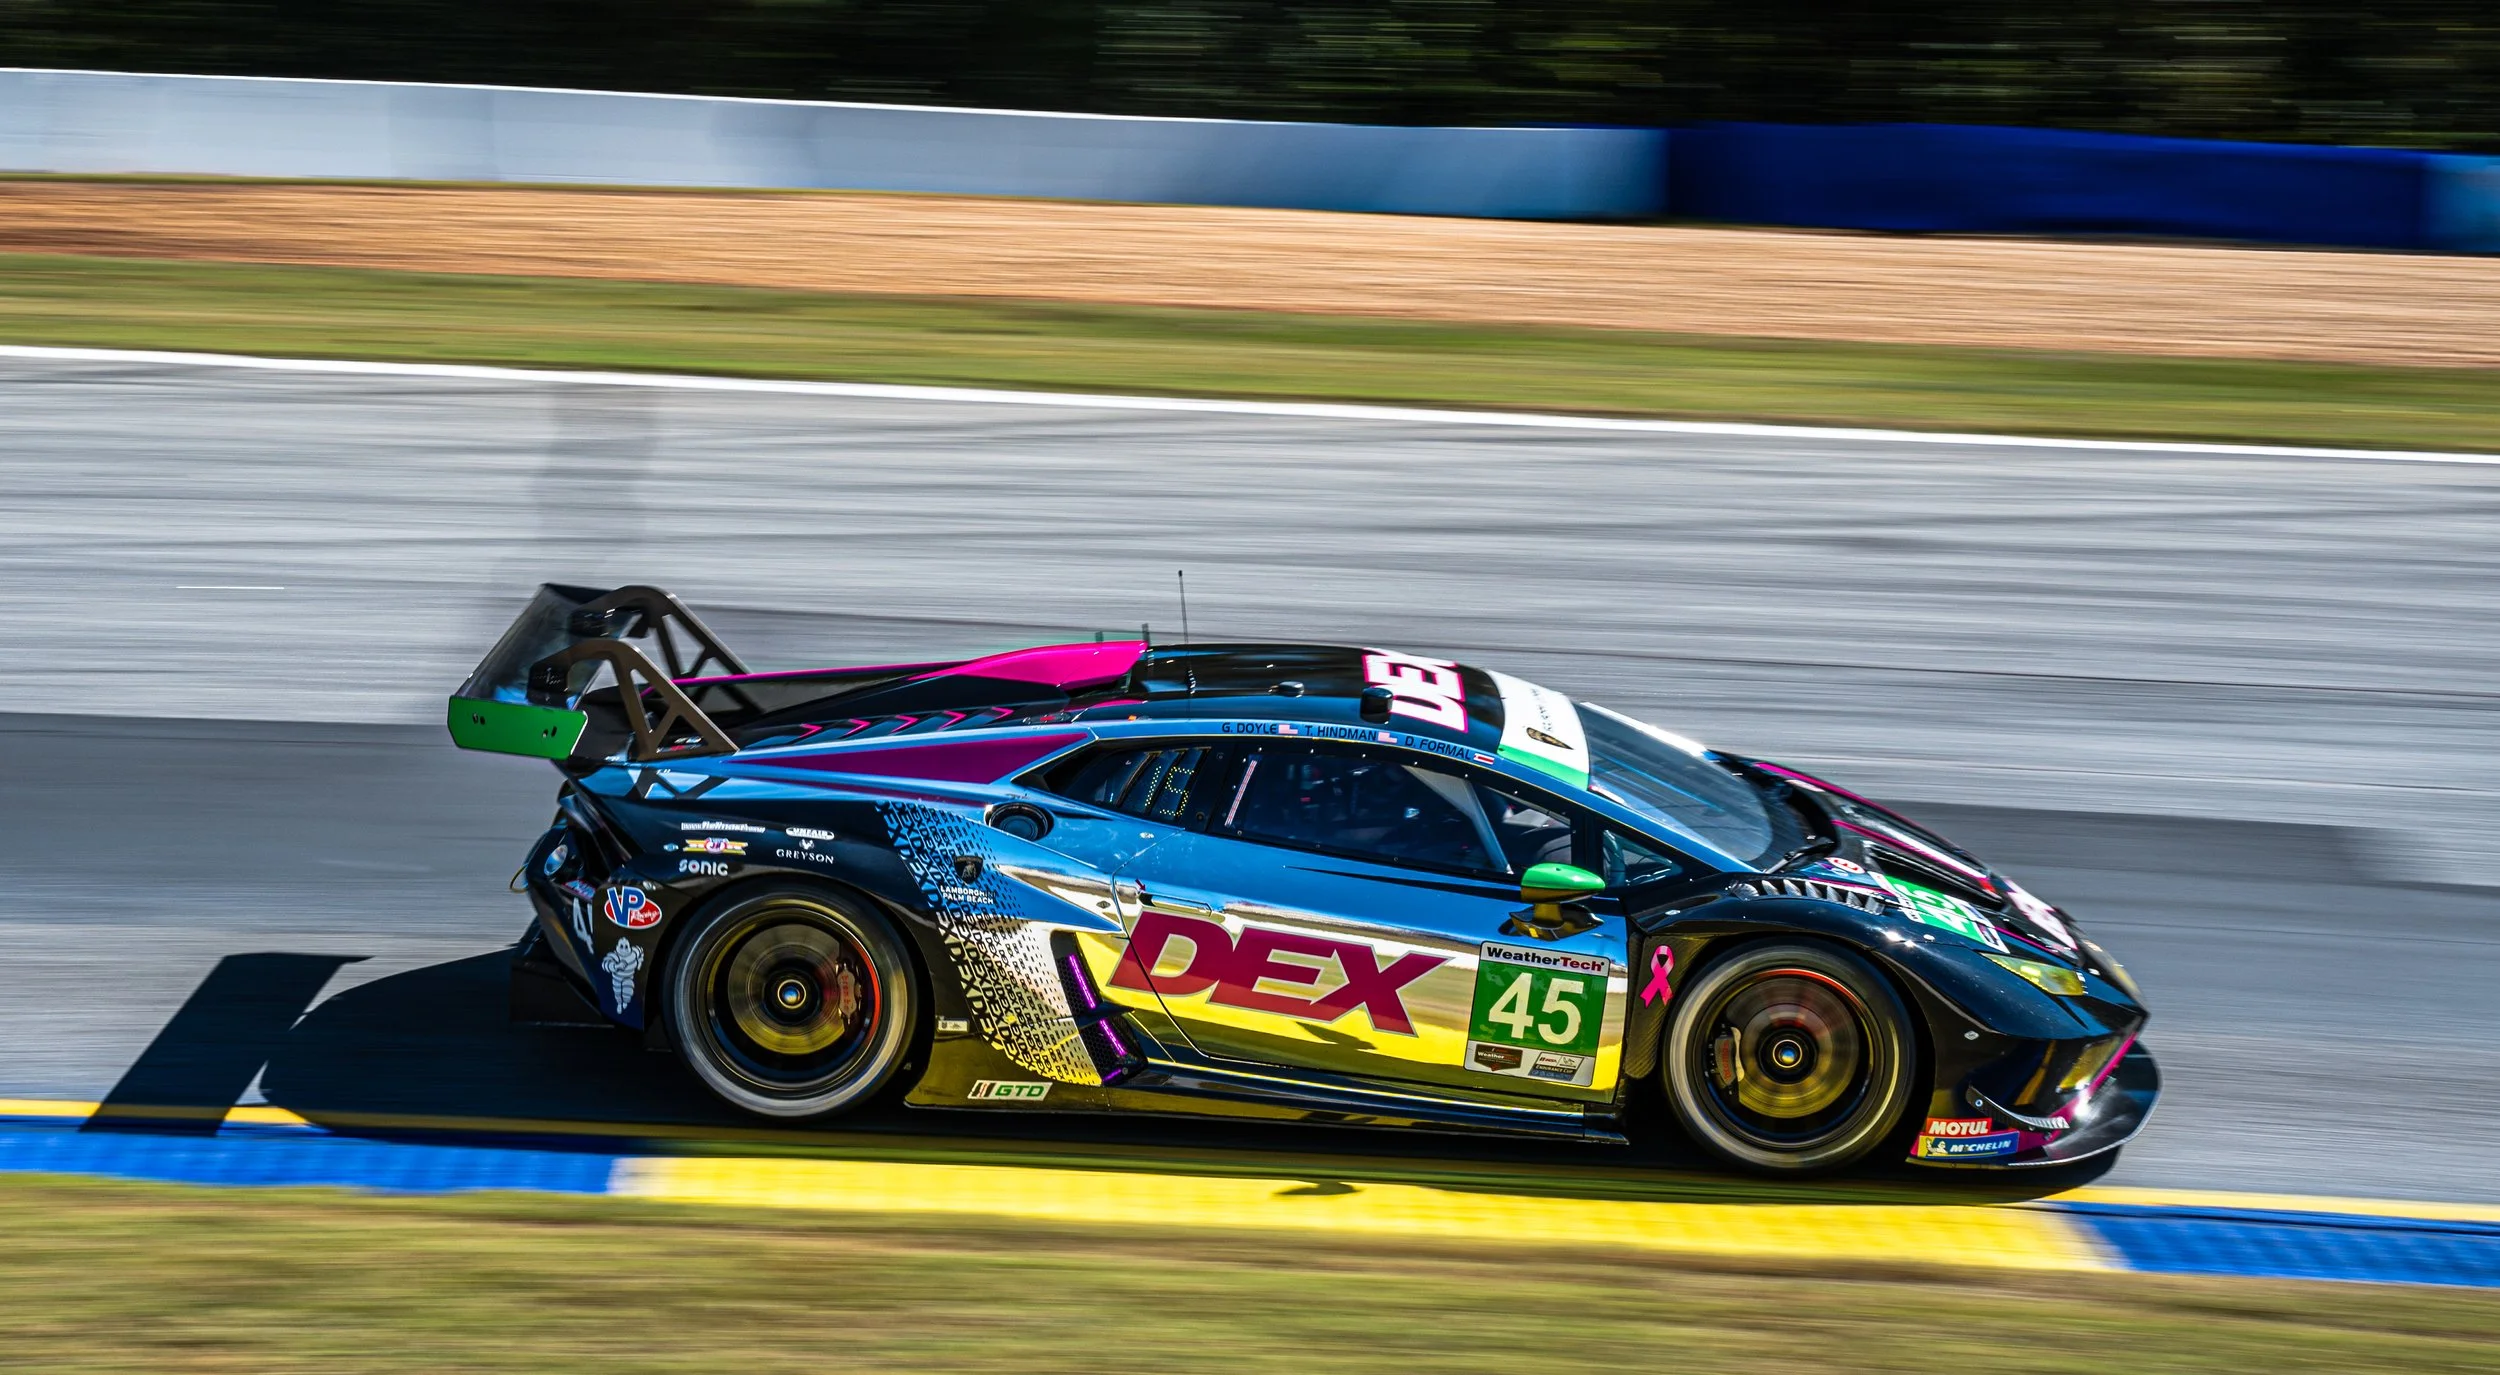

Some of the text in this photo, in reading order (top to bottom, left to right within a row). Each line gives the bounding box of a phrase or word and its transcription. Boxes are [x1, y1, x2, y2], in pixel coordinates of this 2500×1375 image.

[1221, 722, 1278, 734] G. DOYLE
[1304, 725, 1377, 741] T. HINDMAN
[1404, 735, 1471, 760] D. FORMAL
[1144, 765, 1195, 817] 15
[776, 848, 834, 864] GREYSON
[606, 885, 646, 927] VP
[942, 892, 994, 905] PALM BEACH
[1487, 946, 1605, 972] WeatherTech
[1106, 906, 1455, 1037] DEX
[1488, 972, 1585, 1045] 45
[995, 1084, 1045, 1097] GTD
[1928, 1120, 1989, 1136] MOTUL
